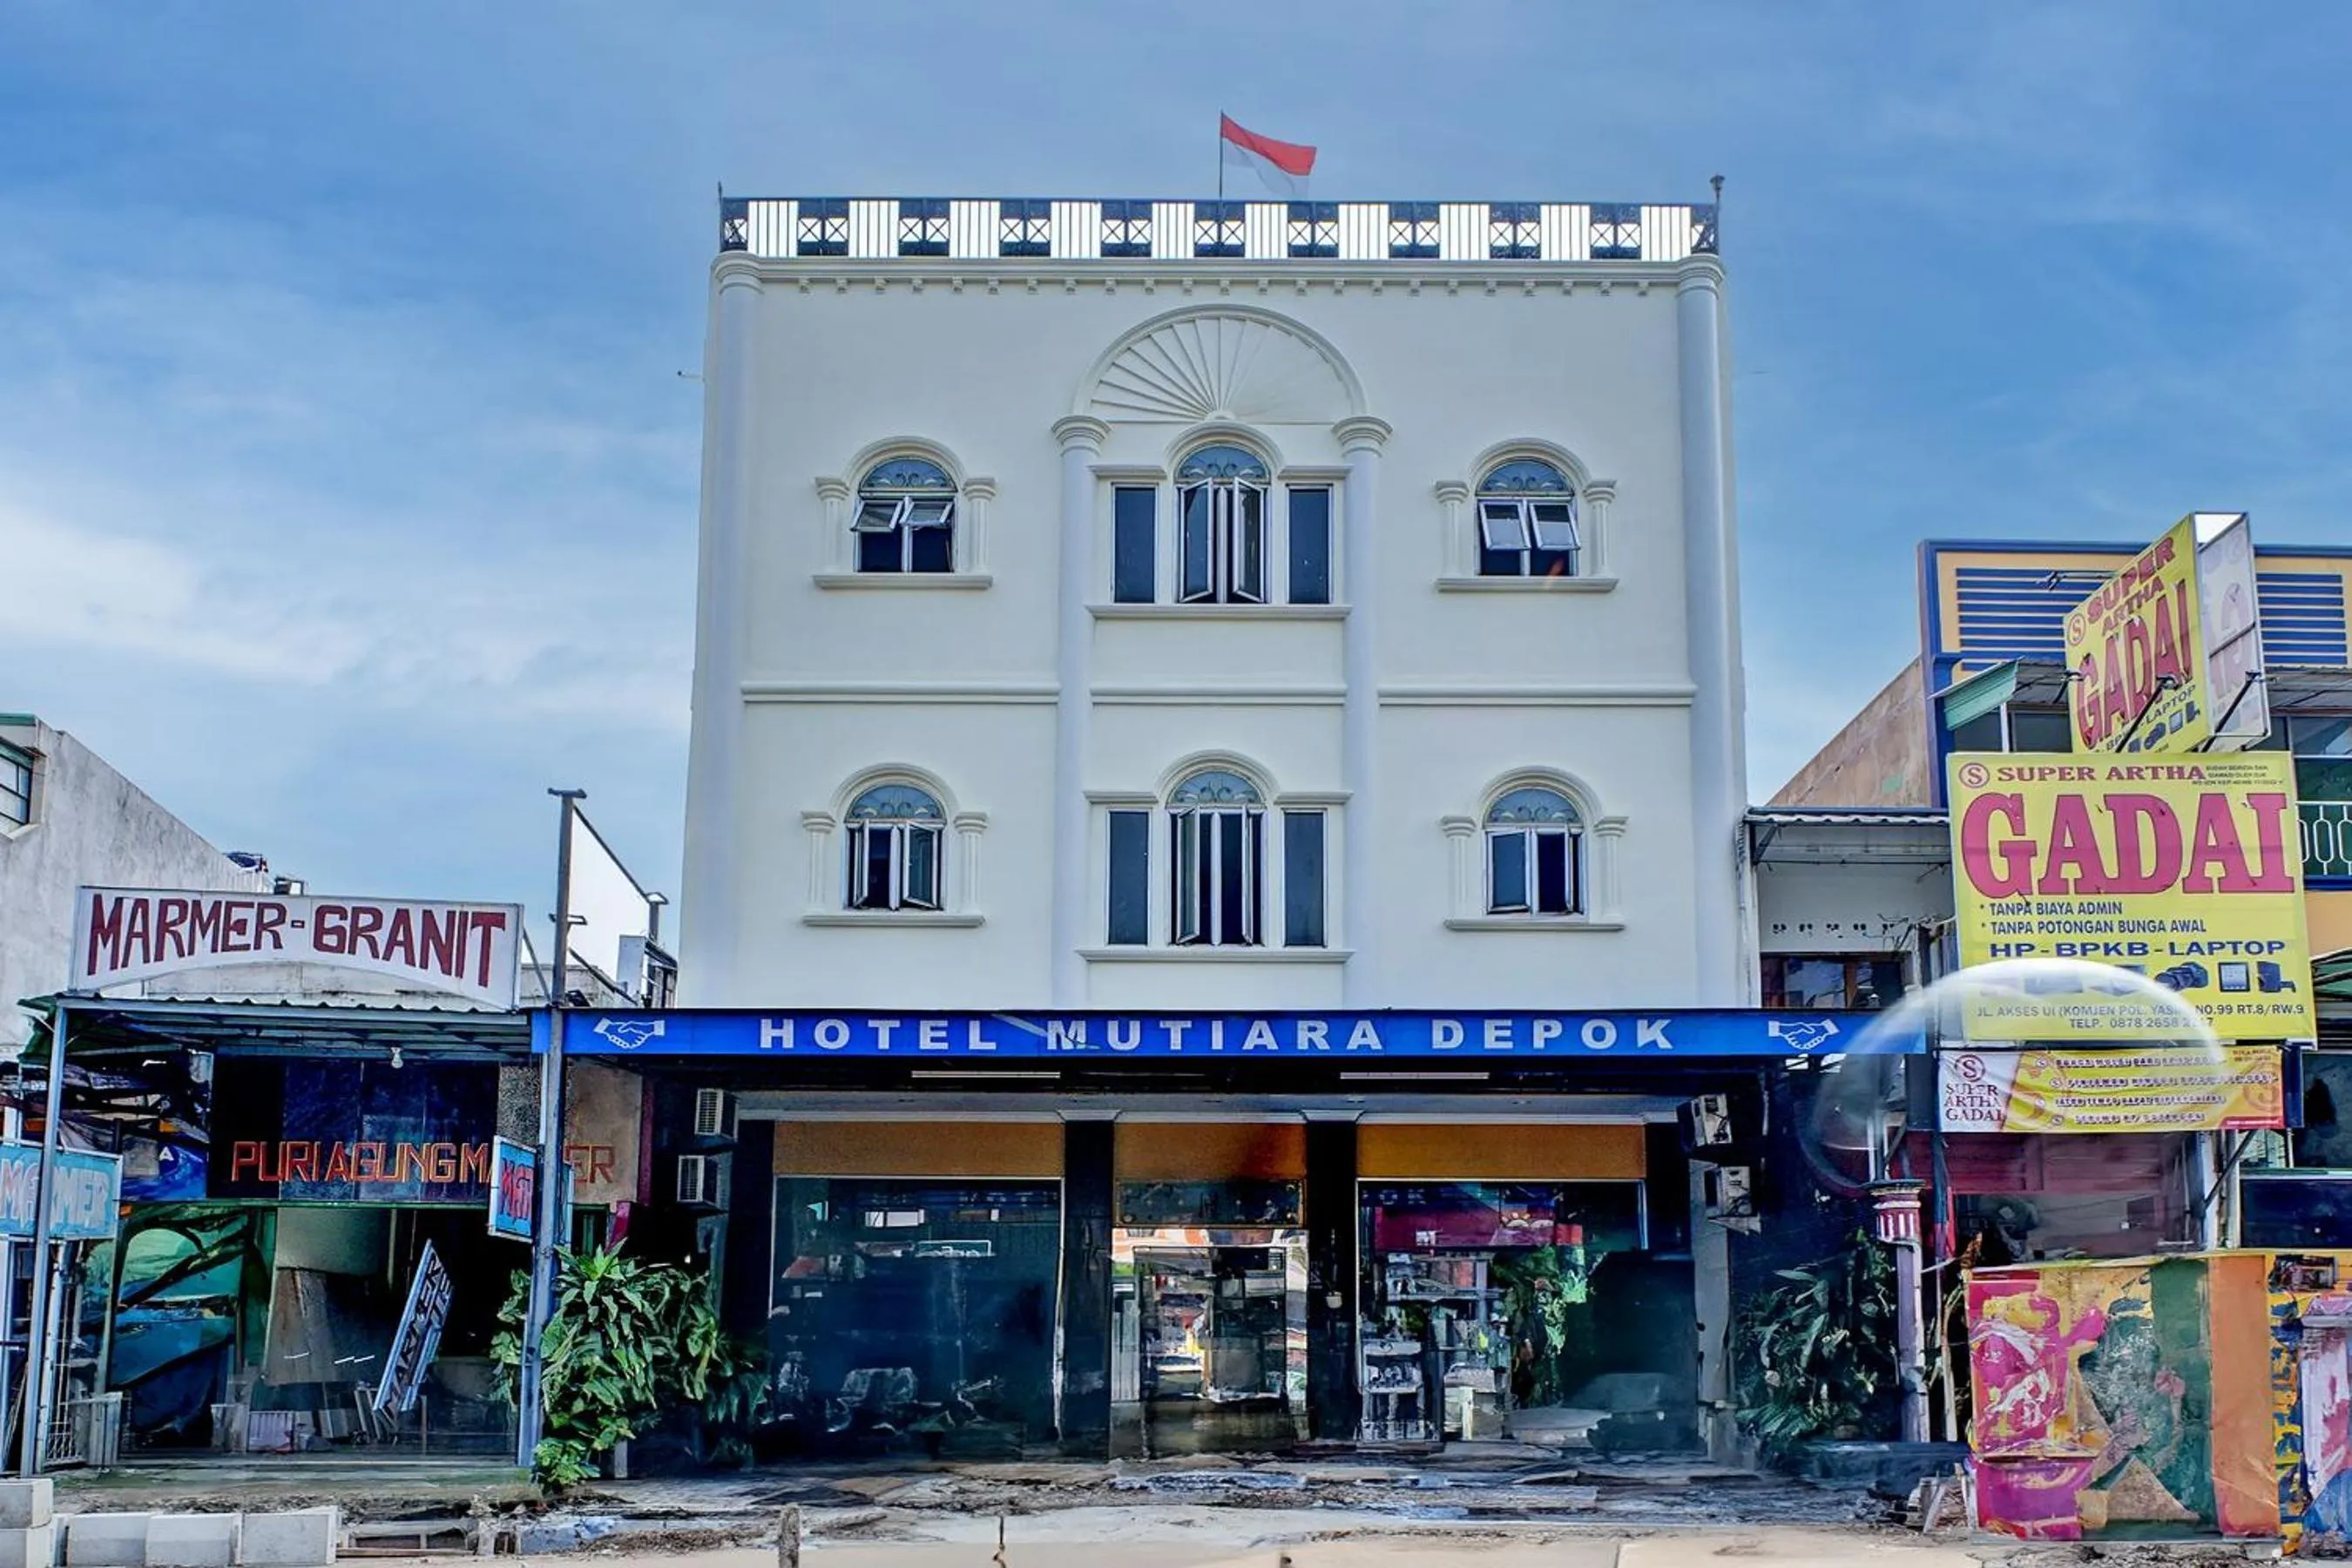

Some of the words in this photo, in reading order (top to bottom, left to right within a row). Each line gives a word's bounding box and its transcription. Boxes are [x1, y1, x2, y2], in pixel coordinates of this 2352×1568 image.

[2086, 537, 2176, 625] SUPER
[2101, 576, 2165, 637] ARTHA
[2077, 578, 2193, 750] GADAI
[1997, 767, 2097, 782] SUPER
[2105, 766, 2207, 781] ARTHA
[1961, 791, 2295, 899] GADAI
[1990, 902, 2032, 916] TANPA
[2037, 902, 2073, 916] BIAYA
[2078, 902, 2123, 915] ADMIN
[1990, 921, 2033, 935] TANPA
[2038, 920, 2114, 934] POTONGAN
[2119, 919, 2166, 933] BUNGA
[2170, 919, 2207, 933] AWAL
[2195, 1004, 2234, 1015] NO.99
[759, 1018, 997, 1051] HOTEL
[1046, 1018, 1384, 1051] MUTIARA
[1431, 1018, 1677, 1050] DEPOK
[1945, 1107, 2004, 1121] GADAI
[0, 1156, 112, 1230] MAMER
